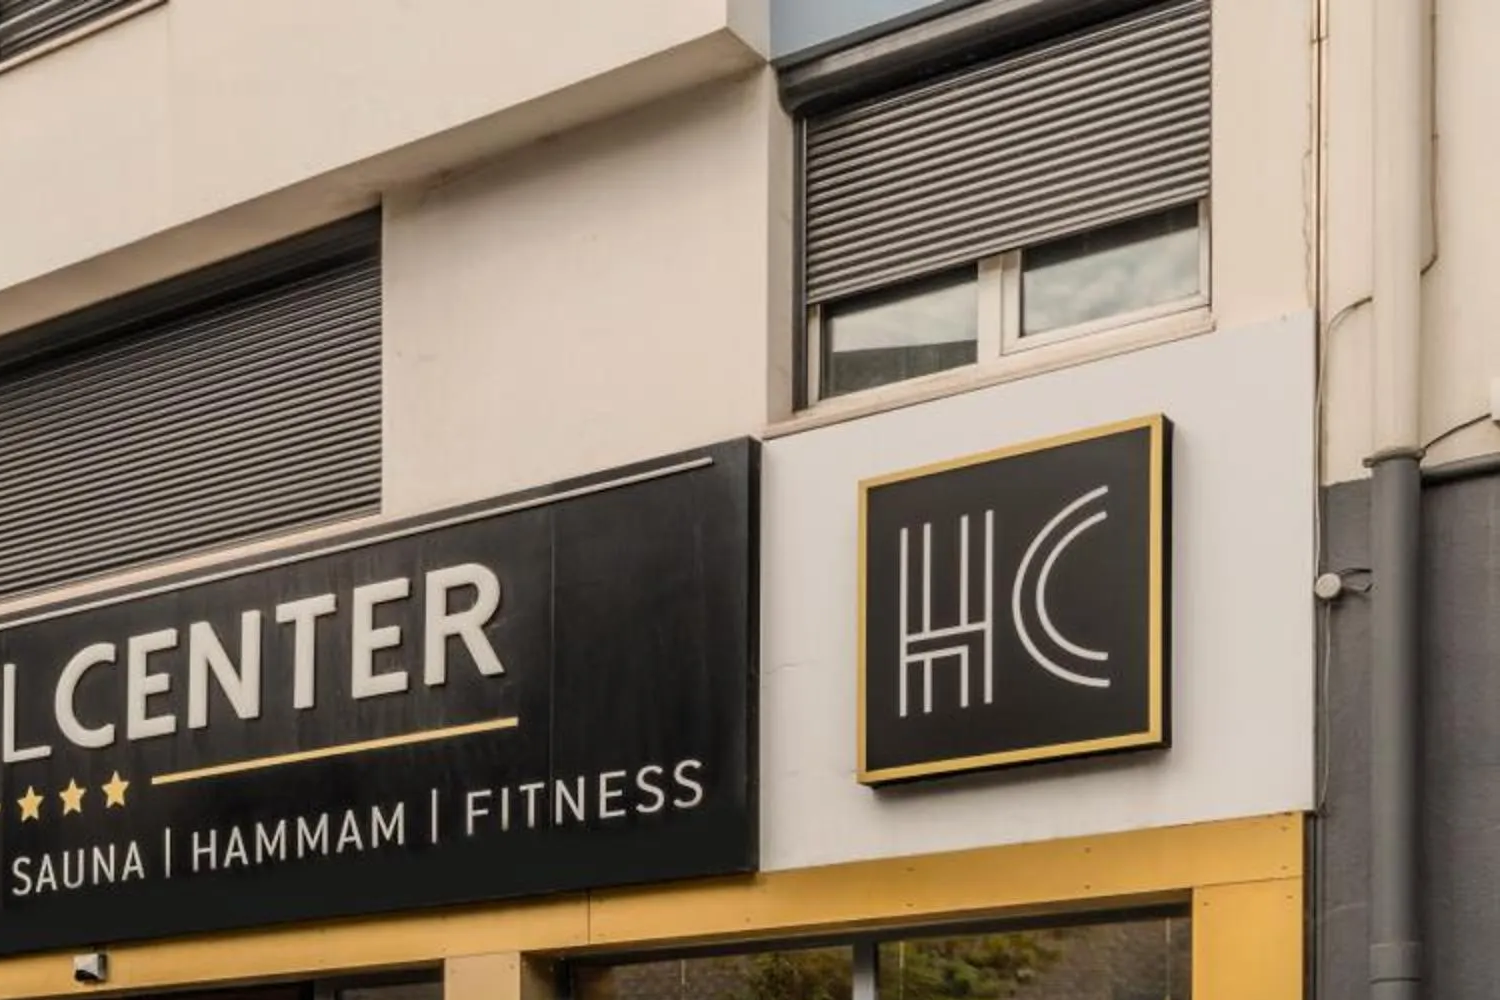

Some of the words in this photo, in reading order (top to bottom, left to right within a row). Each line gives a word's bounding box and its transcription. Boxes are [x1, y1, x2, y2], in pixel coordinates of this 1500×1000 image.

[899, 485, 1111, 717] HC
[12, 841, 145, 896] SAUNA
[192, 801, 404, 872] HAMMAM
[466, 758, 704, 836] FITNESS
